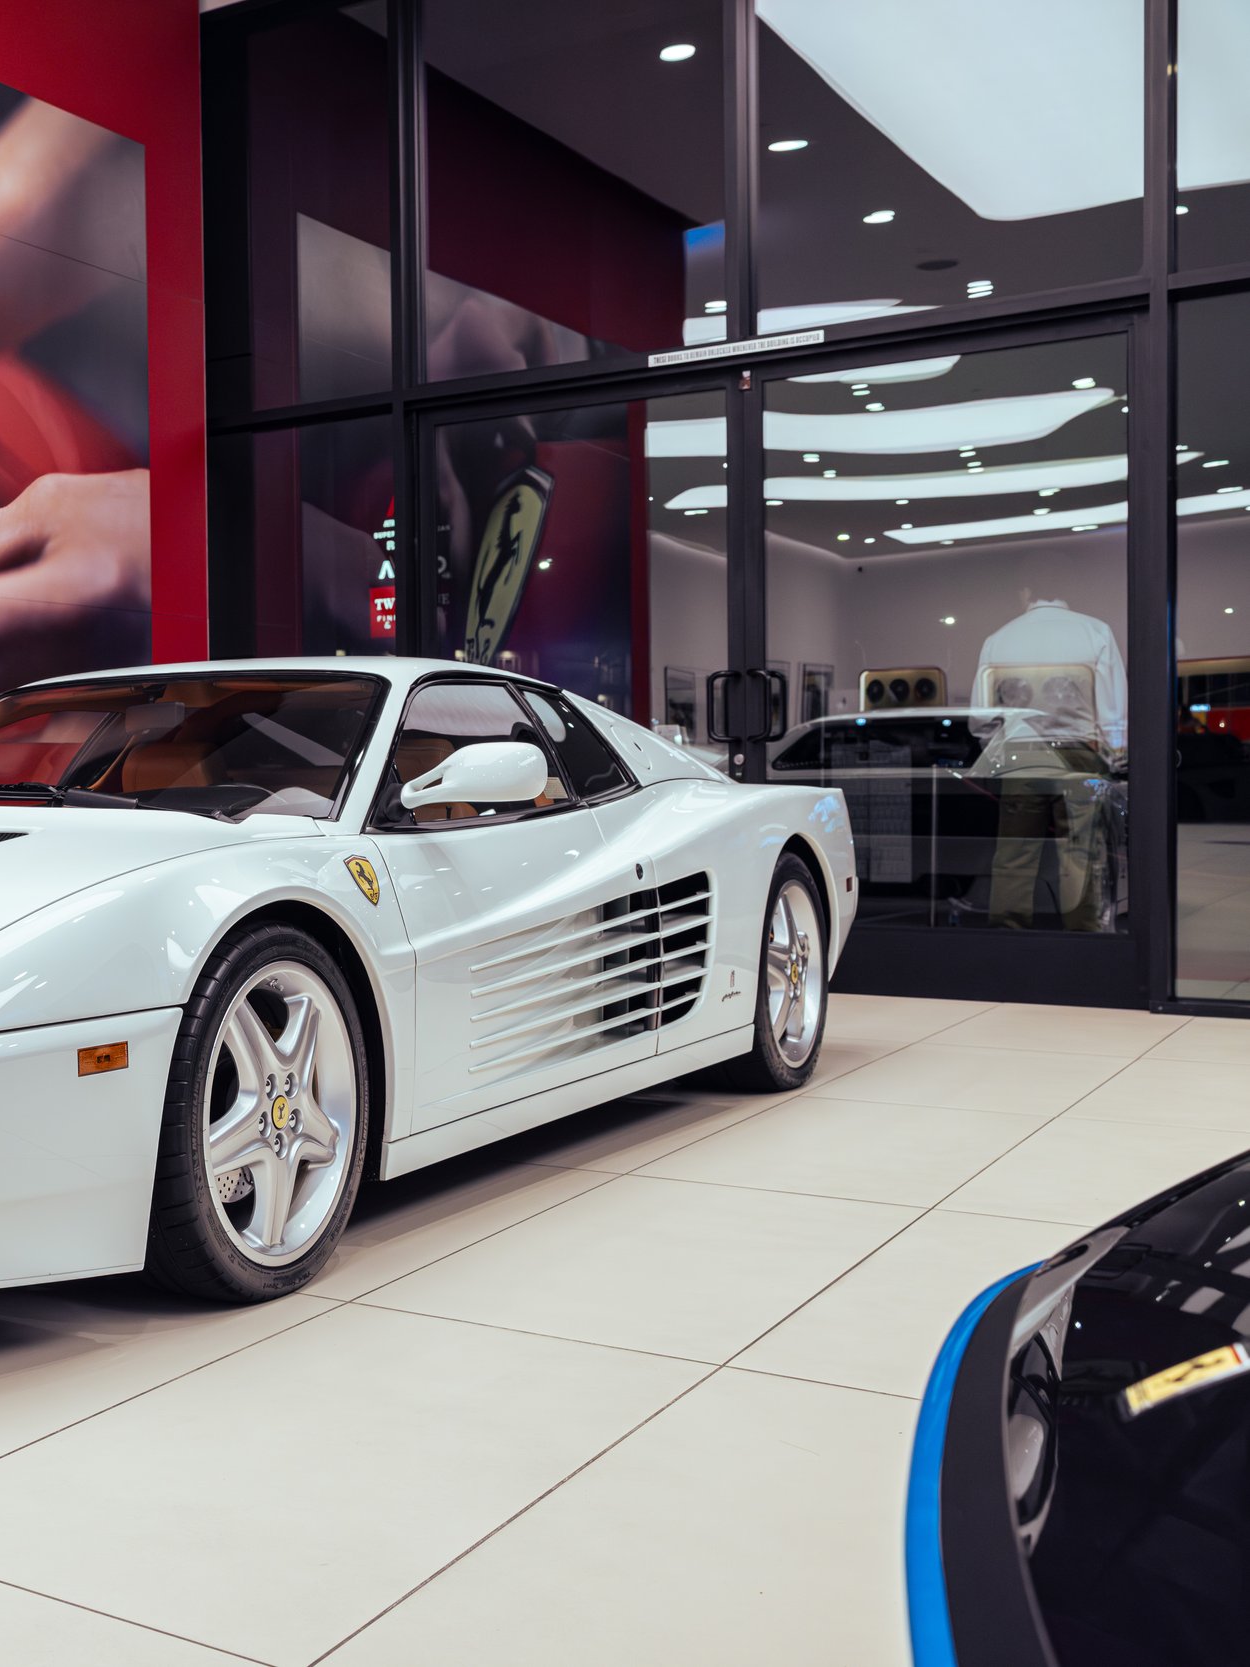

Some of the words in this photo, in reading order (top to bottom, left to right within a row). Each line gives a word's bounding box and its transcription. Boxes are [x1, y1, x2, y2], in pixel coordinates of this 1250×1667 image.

[653, 355, 667, 364] THESE
[668, 354, 682, 362] DOORS
[683, 352, 689, 360] TO
[690, 349, 707, 359] REMAIN
[708, 346, 730, 357] UNLOCKED
[757, 340, 766, 349] THE
[767, 337, 788, 348] BUILDING
[796, 333, 819, 344] OCCUPIED
